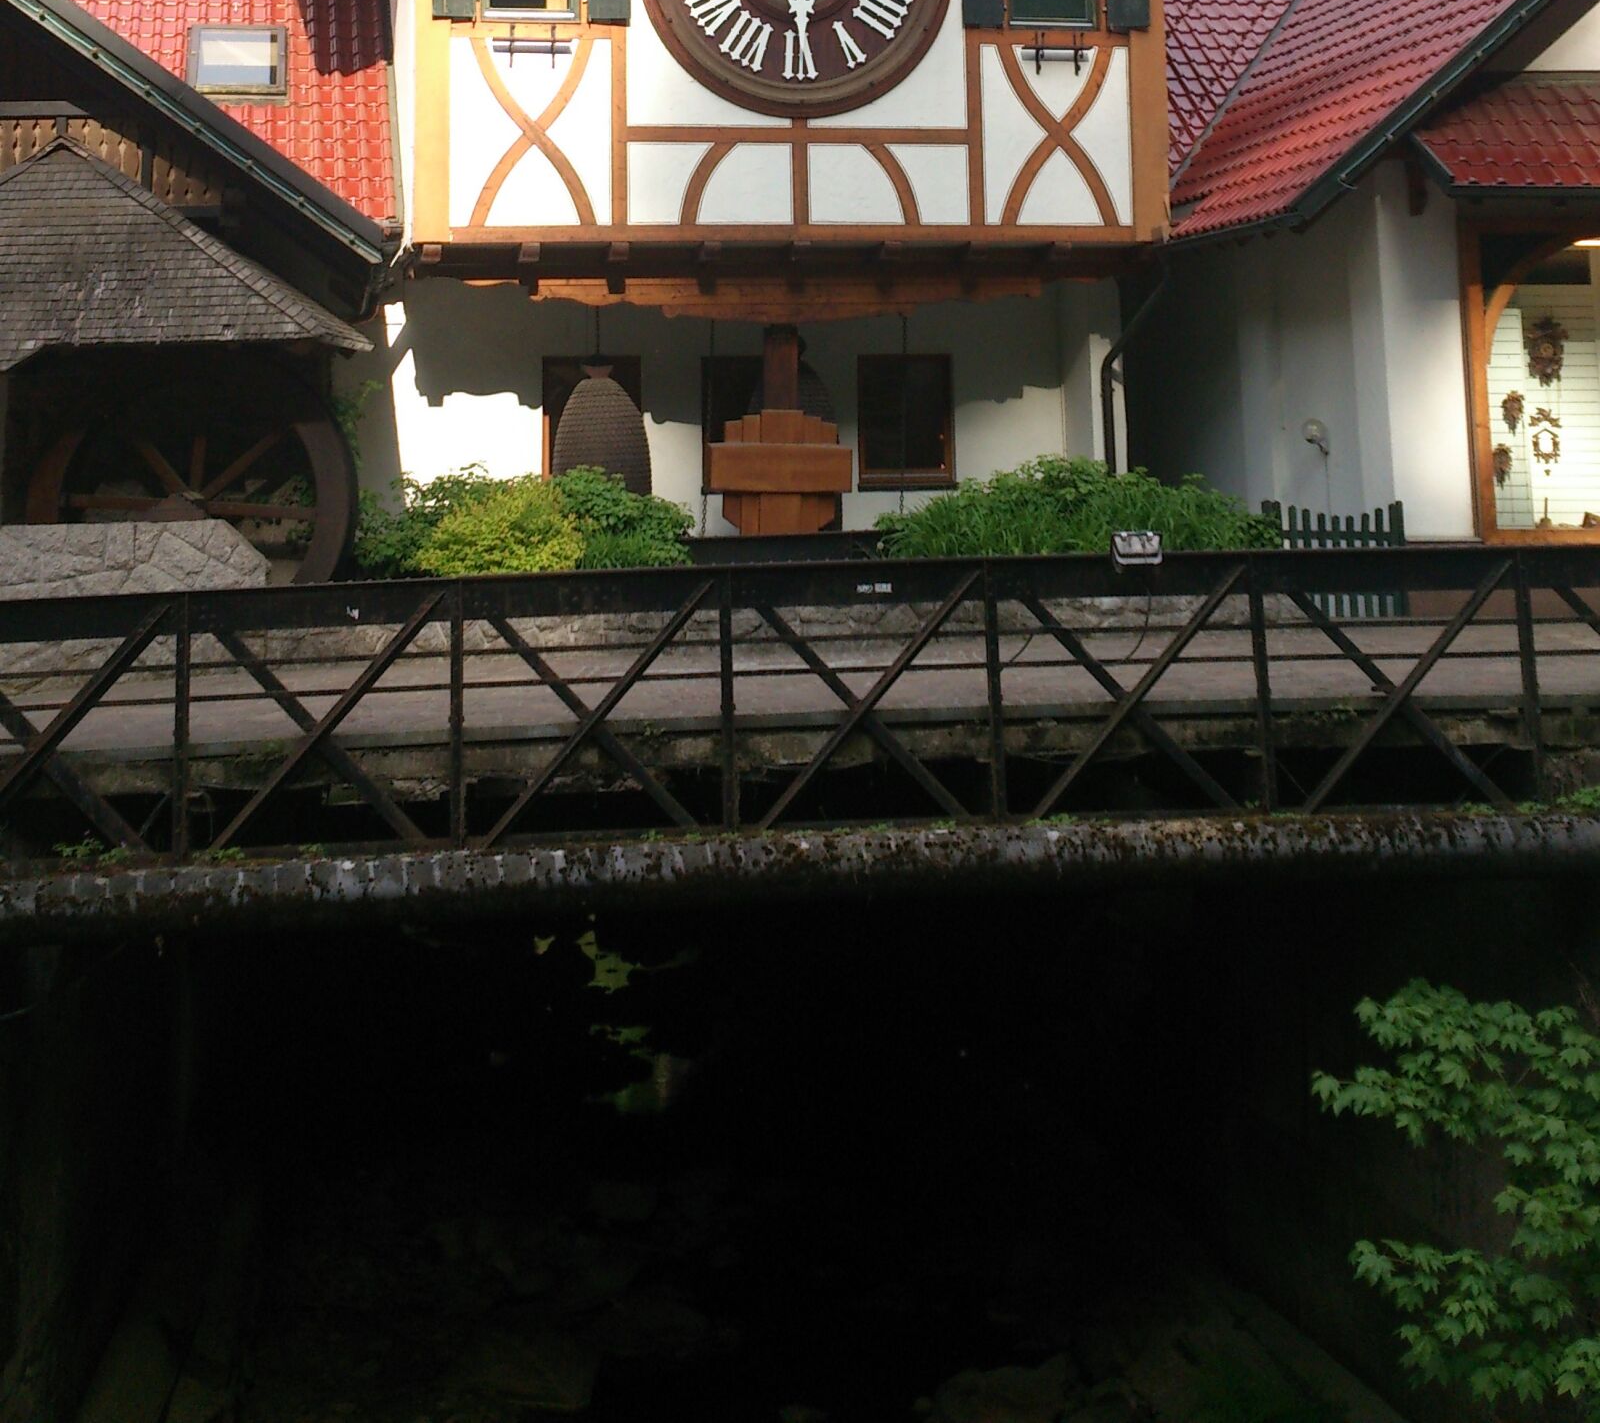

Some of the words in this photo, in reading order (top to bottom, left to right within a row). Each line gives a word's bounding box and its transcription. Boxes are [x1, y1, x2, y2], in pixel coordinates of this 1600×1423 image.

[719, 10, 774, 72] VII
[782, 29, 819, 81] VI
[832, 21, 867, 69] V
